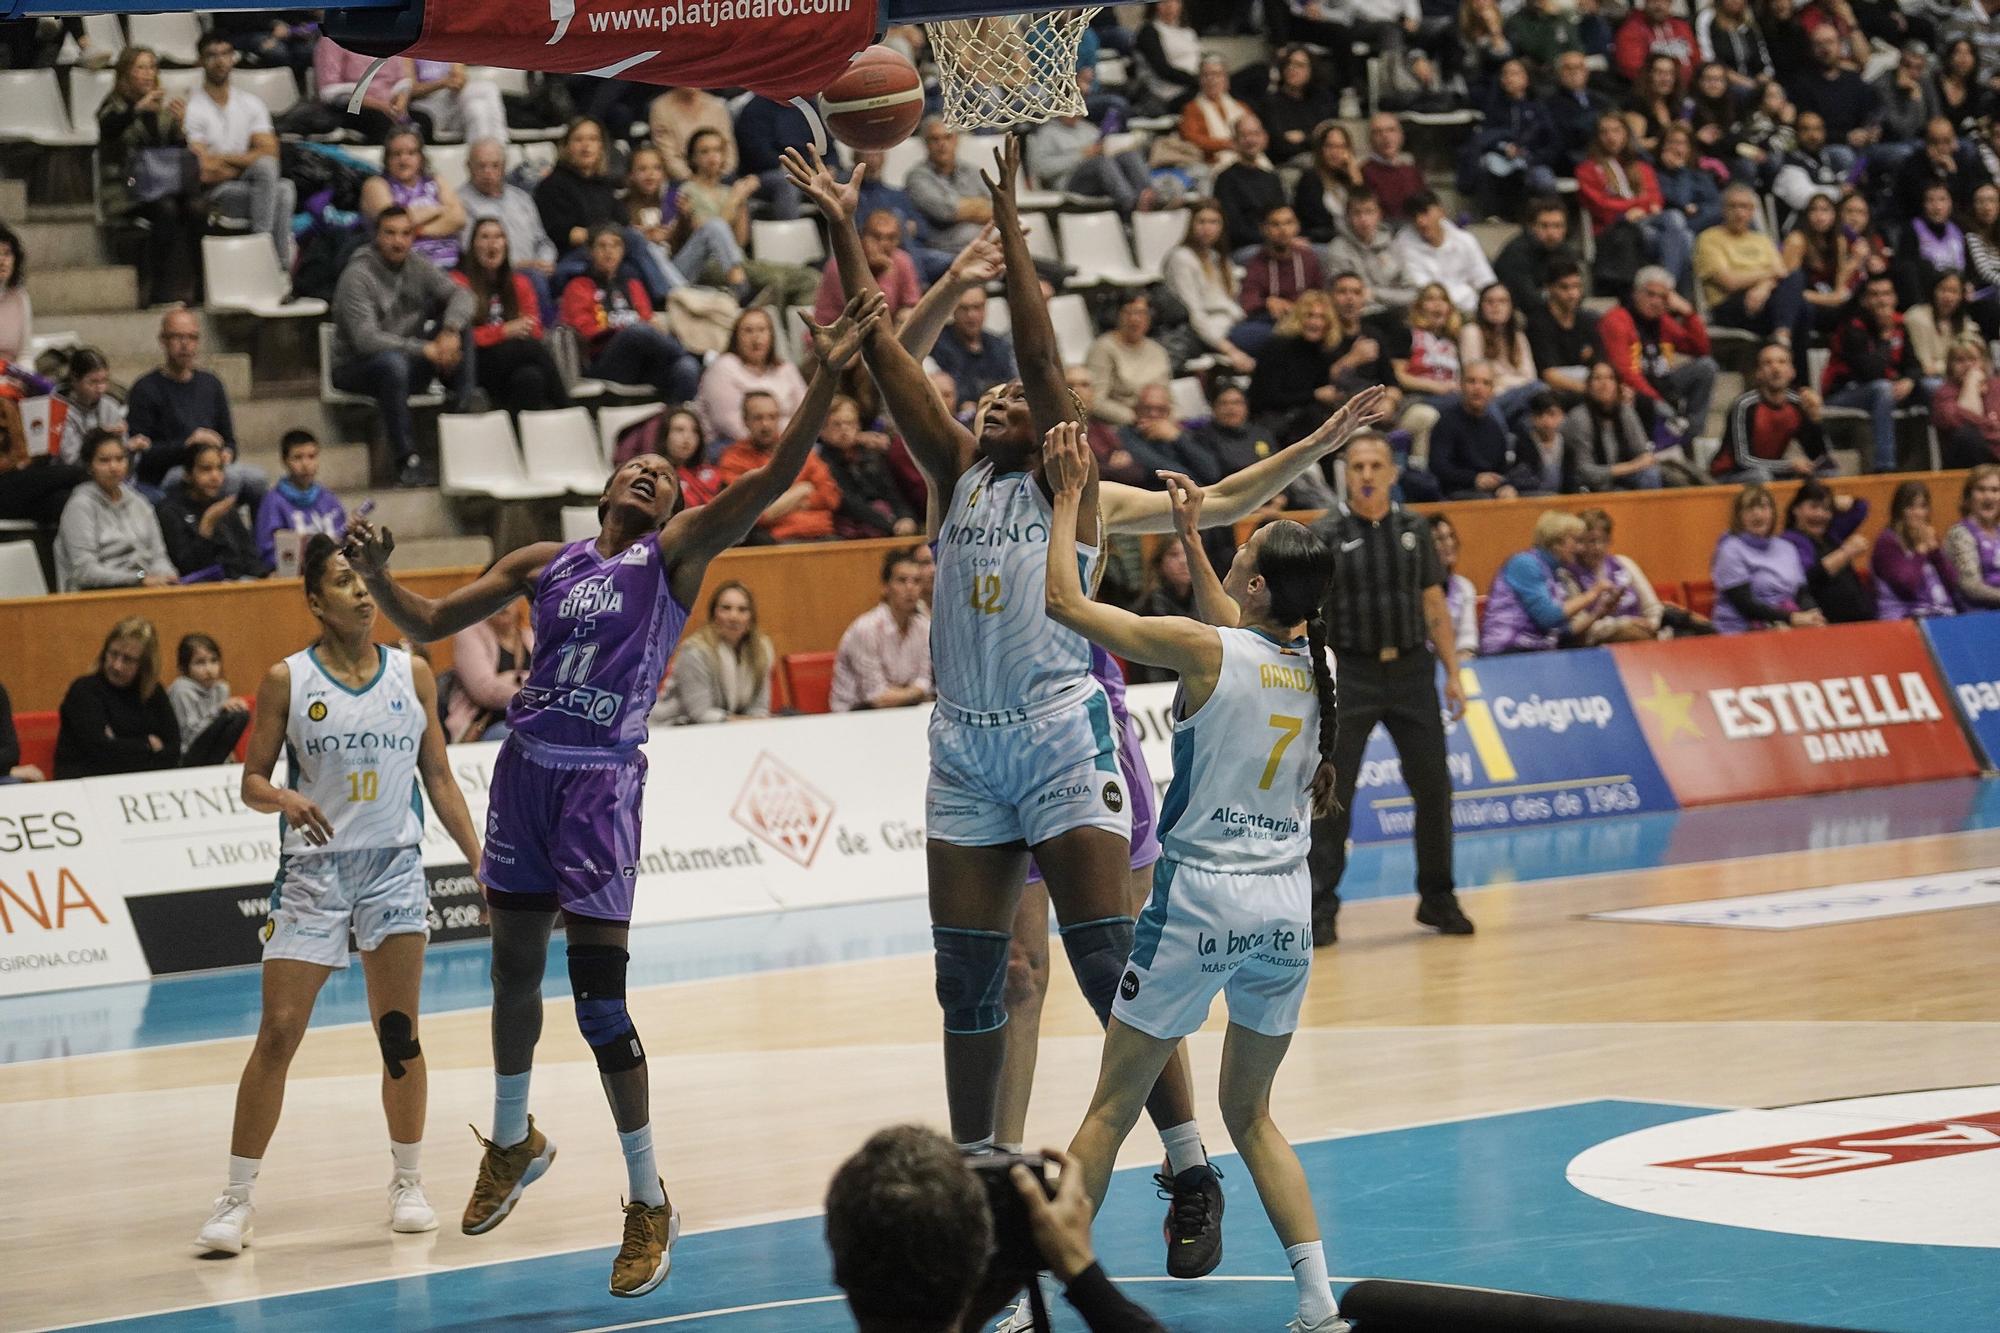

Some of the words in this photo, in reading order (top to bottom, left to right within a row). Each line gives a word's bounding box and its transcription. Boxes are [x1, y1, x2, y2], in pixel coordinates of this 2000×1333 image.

[555, 644, 600, 689] 11
[1708, 671, 1943, 740] ESTRELLA
[306, 732, 415, 756] HOZONO
[1258, 714, 1303, 790] 7
[1803, 729, 1889, 763] DAMM
[346, 770, 378, 803] 10
[1554, 792, 1583, 817] de
[836, 823, 870, 856] de
[1198, 931, 1217, 957] la
[1226, 929, 1265, 956] boca
[1272, 928, 1296, 952] te
[1201, 961, 1226, 973] MÁS
